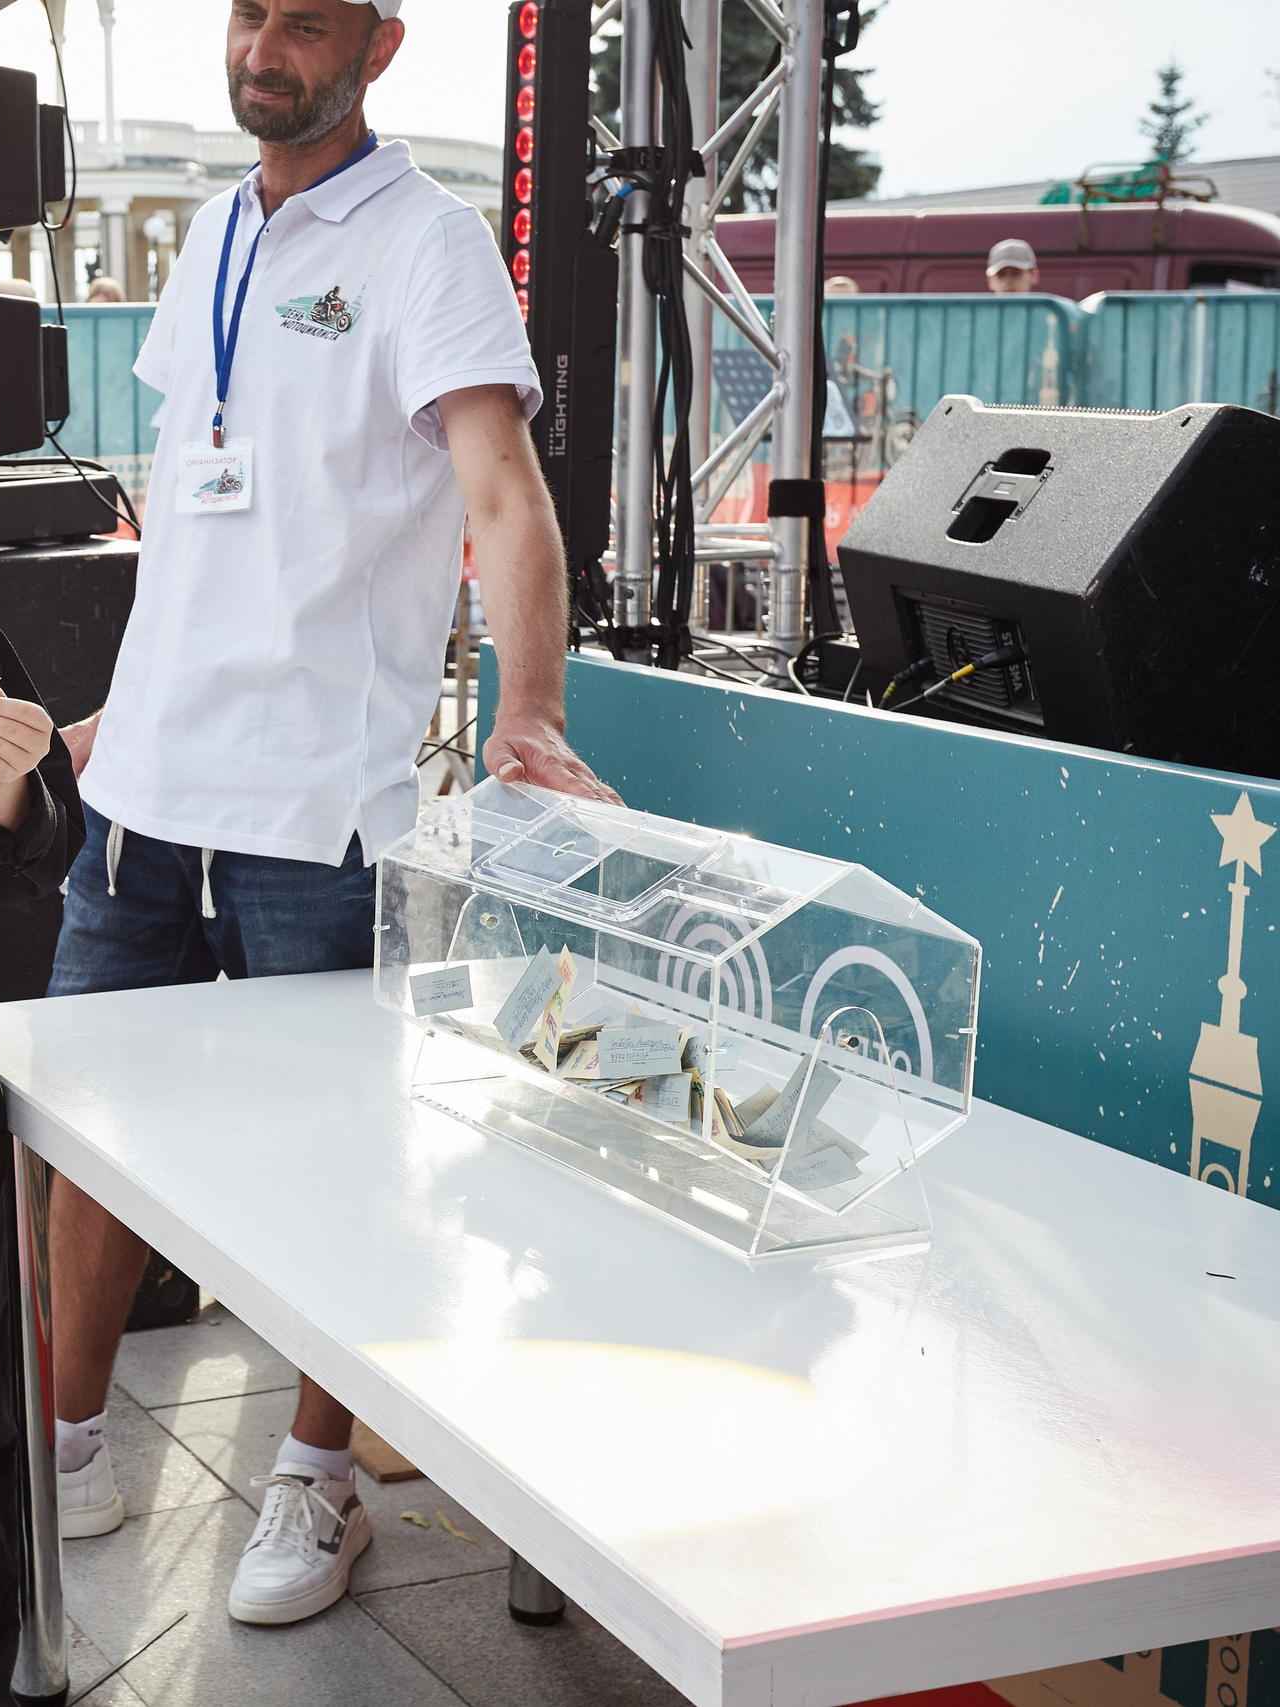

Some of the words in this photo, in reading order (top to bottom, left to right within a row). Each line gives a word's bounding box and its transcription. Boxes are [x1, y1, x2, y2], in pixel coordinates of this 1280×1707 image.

[280, 308, 306, 321] ДЕНЬ
[280, 319, 341, 342] МОТОЦИКЛИСТА
[186, 457, 237, 466] ОРГАНИЗАТОР
